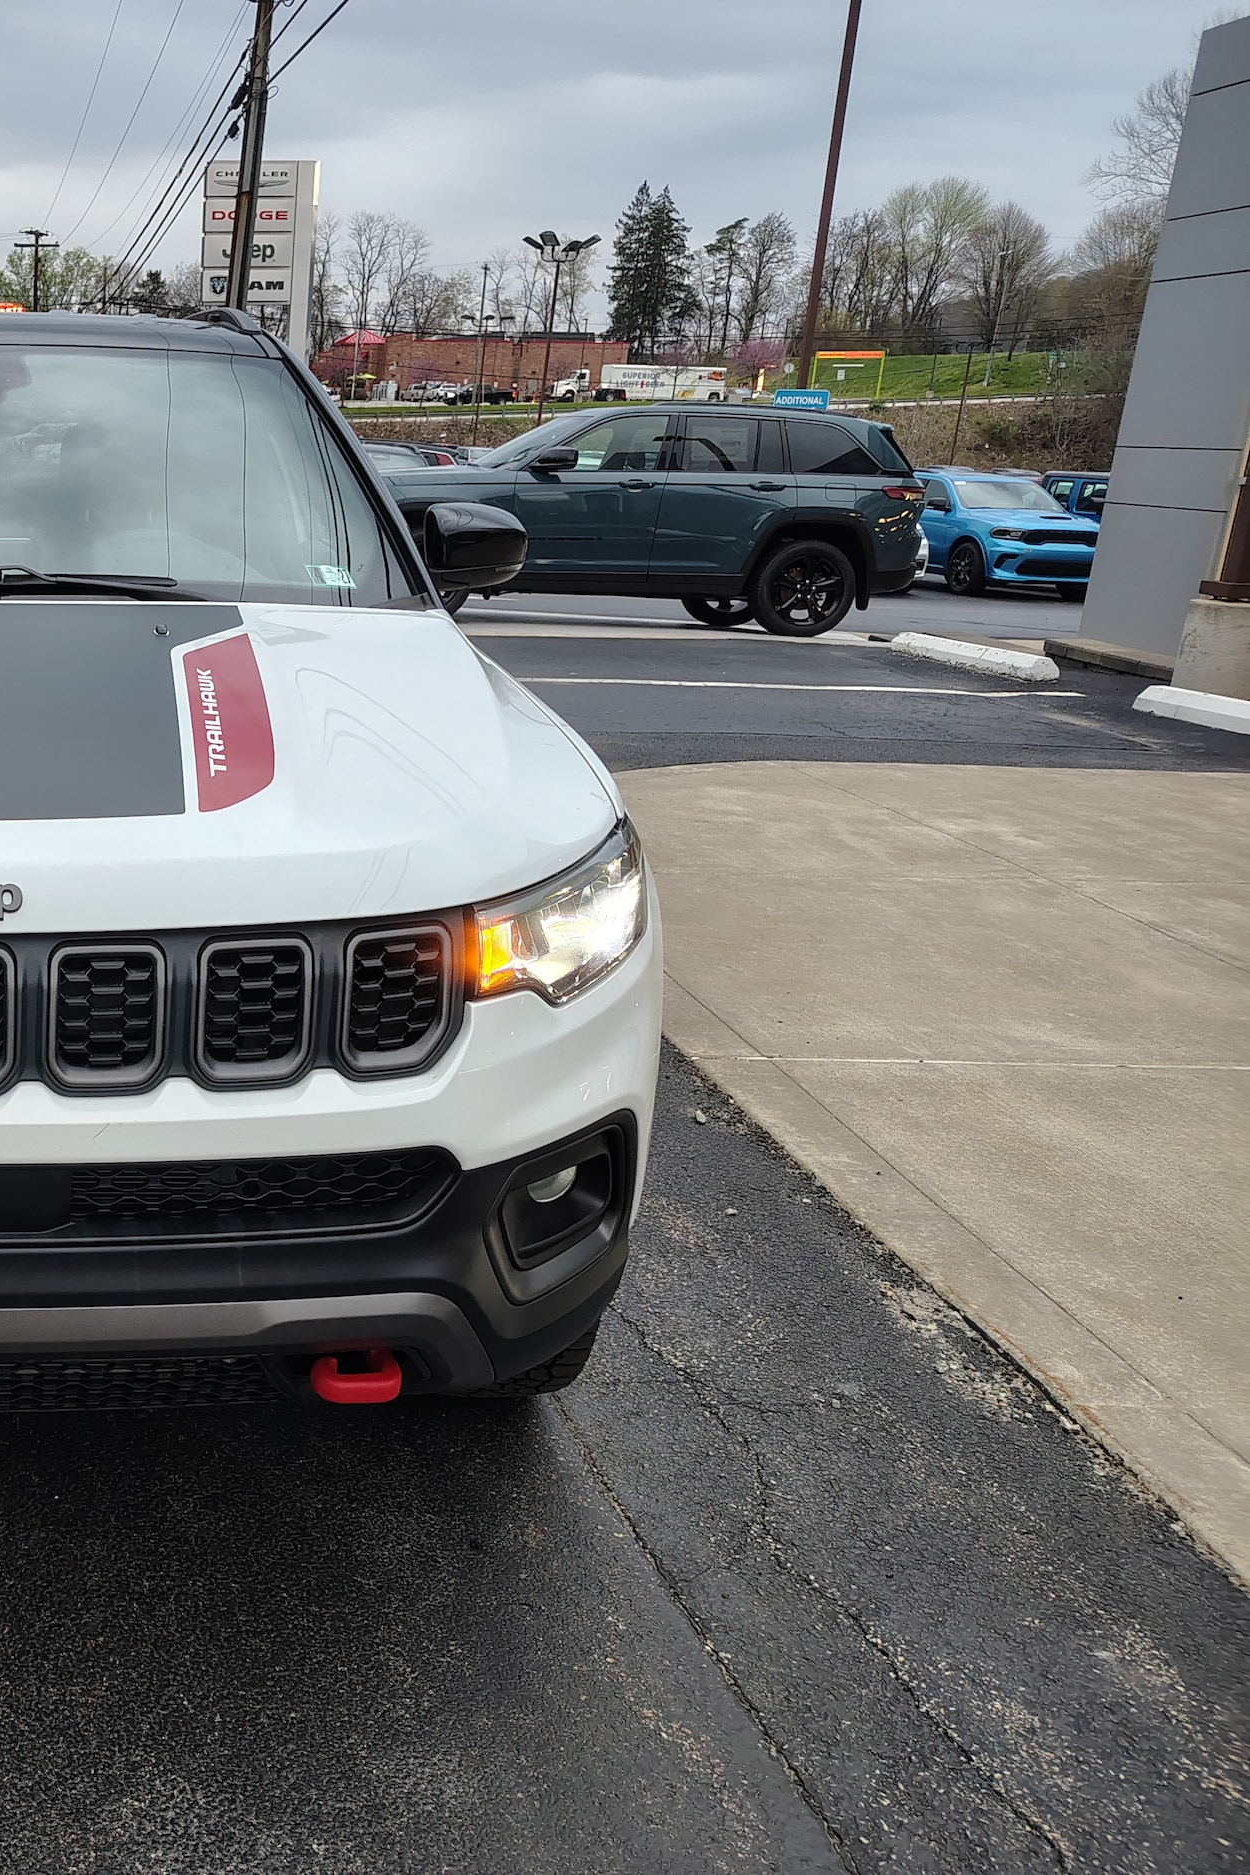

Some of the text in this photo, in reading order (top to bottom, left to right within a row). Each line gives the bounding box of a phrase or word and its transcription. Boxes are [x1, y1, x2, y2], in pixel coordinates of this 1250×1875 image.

[211, 210, 289, 221] DOGE
[221, 243, 275, 262] Jep
[248, 280, 284, 290] AM
[622, 371, 661, 380] SUPERIOR
[616, 380, 639, 388] LIGHT
[775, 396, 824, 405] ADDITIONAL
[195, 667, 228, 778] TRAILHAWK
